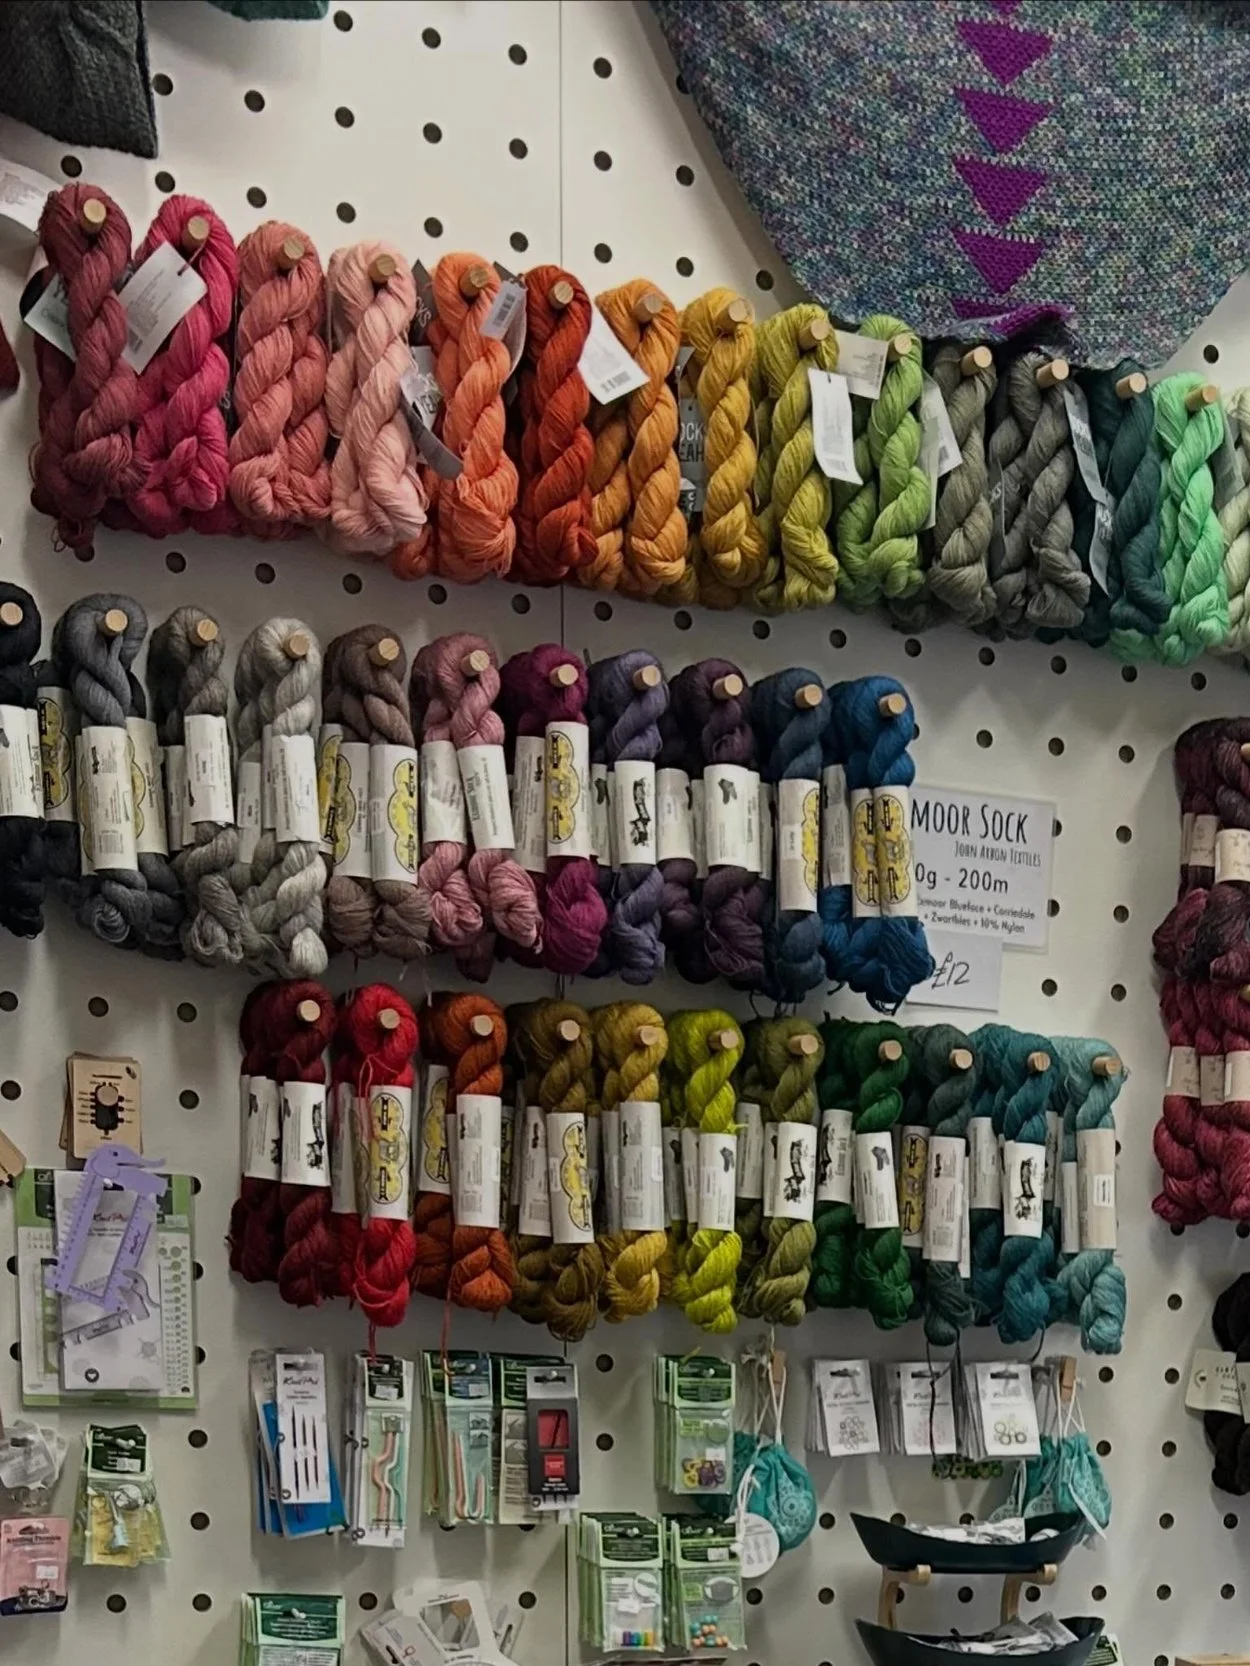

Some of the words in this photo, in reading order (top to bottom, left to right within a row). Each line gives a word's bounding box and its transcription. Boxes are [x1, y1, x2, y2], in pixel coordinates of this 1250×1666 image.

[910, 799, 971, 837] MOOR
[979, 803, 1029, 844] SOCK
[954, 840, 978, 859] JOHN
[1009, 848, 1042, 868] TEXTILES
[915, 862, 937, 890] 0g
[958, 867, 1009, 895] 200m
[1001, 921, 1026, 935] Nylon
